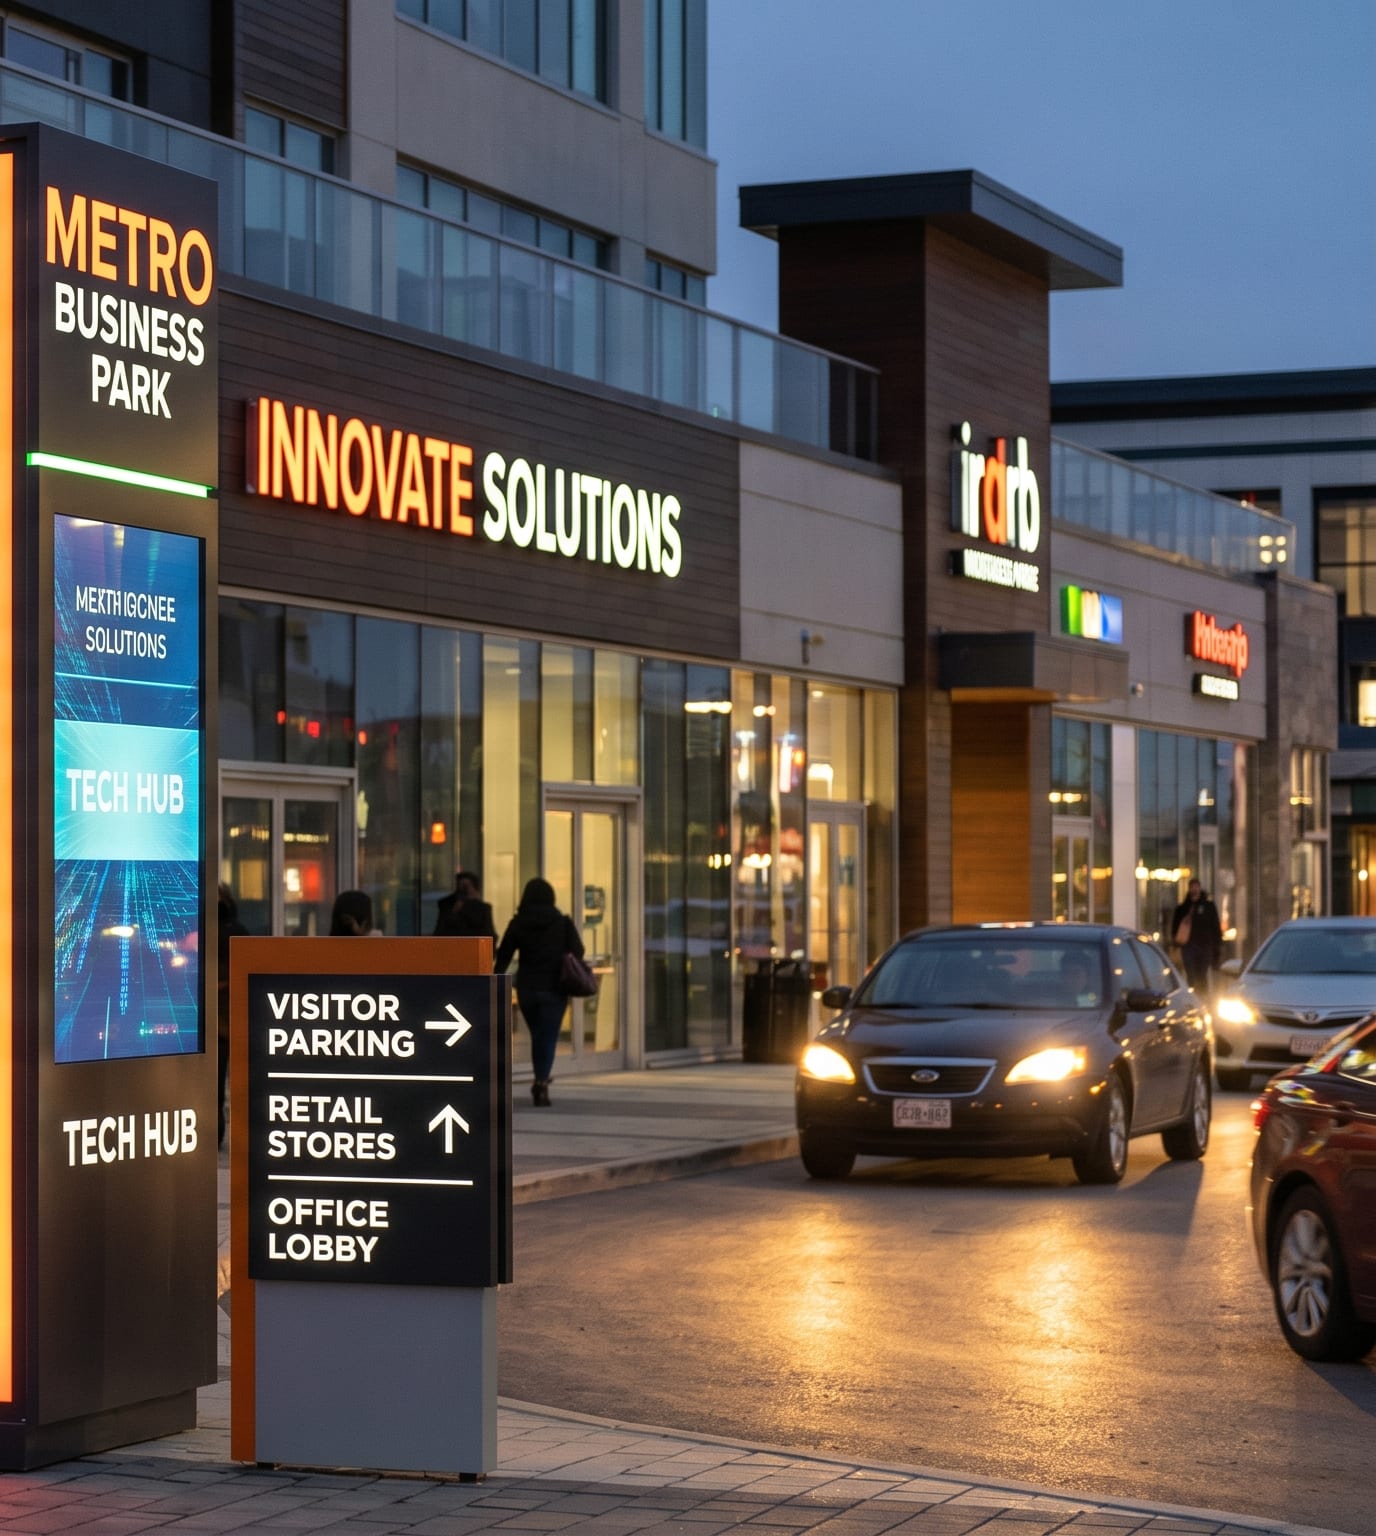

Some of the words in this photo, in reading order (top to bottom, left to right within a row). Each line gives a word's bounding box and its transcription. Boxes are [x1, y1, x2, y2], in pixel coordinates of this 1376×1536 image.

[46, 185, 214, 307] METRO
[55, 281, 205, 376] BUSINESS
[91, 353, 172, 419] PARK
[257, 396, 474, 537] INNOVATE
[482, 451, 682, 579] SOLUTIONS
[85, 624, 167, 660] SOLUTIONS
[66, 768, 129, 814] TECH
[135, 770, 184, 814] HUB
[267, 992, 400, 1022] VISITOR
[267, 1028, 416, 1058] PARKING
[268, 1095, 384, 1125] RETAIL
[62, 1113, 136, 1168] TECH
[143, 1107, 198, 1159] HUB
[267, 1130, 397, 1161] STORES
[268, 1197, 390, 1228] OFFICE
[268, 1232, 380, 1264] LOBBY
